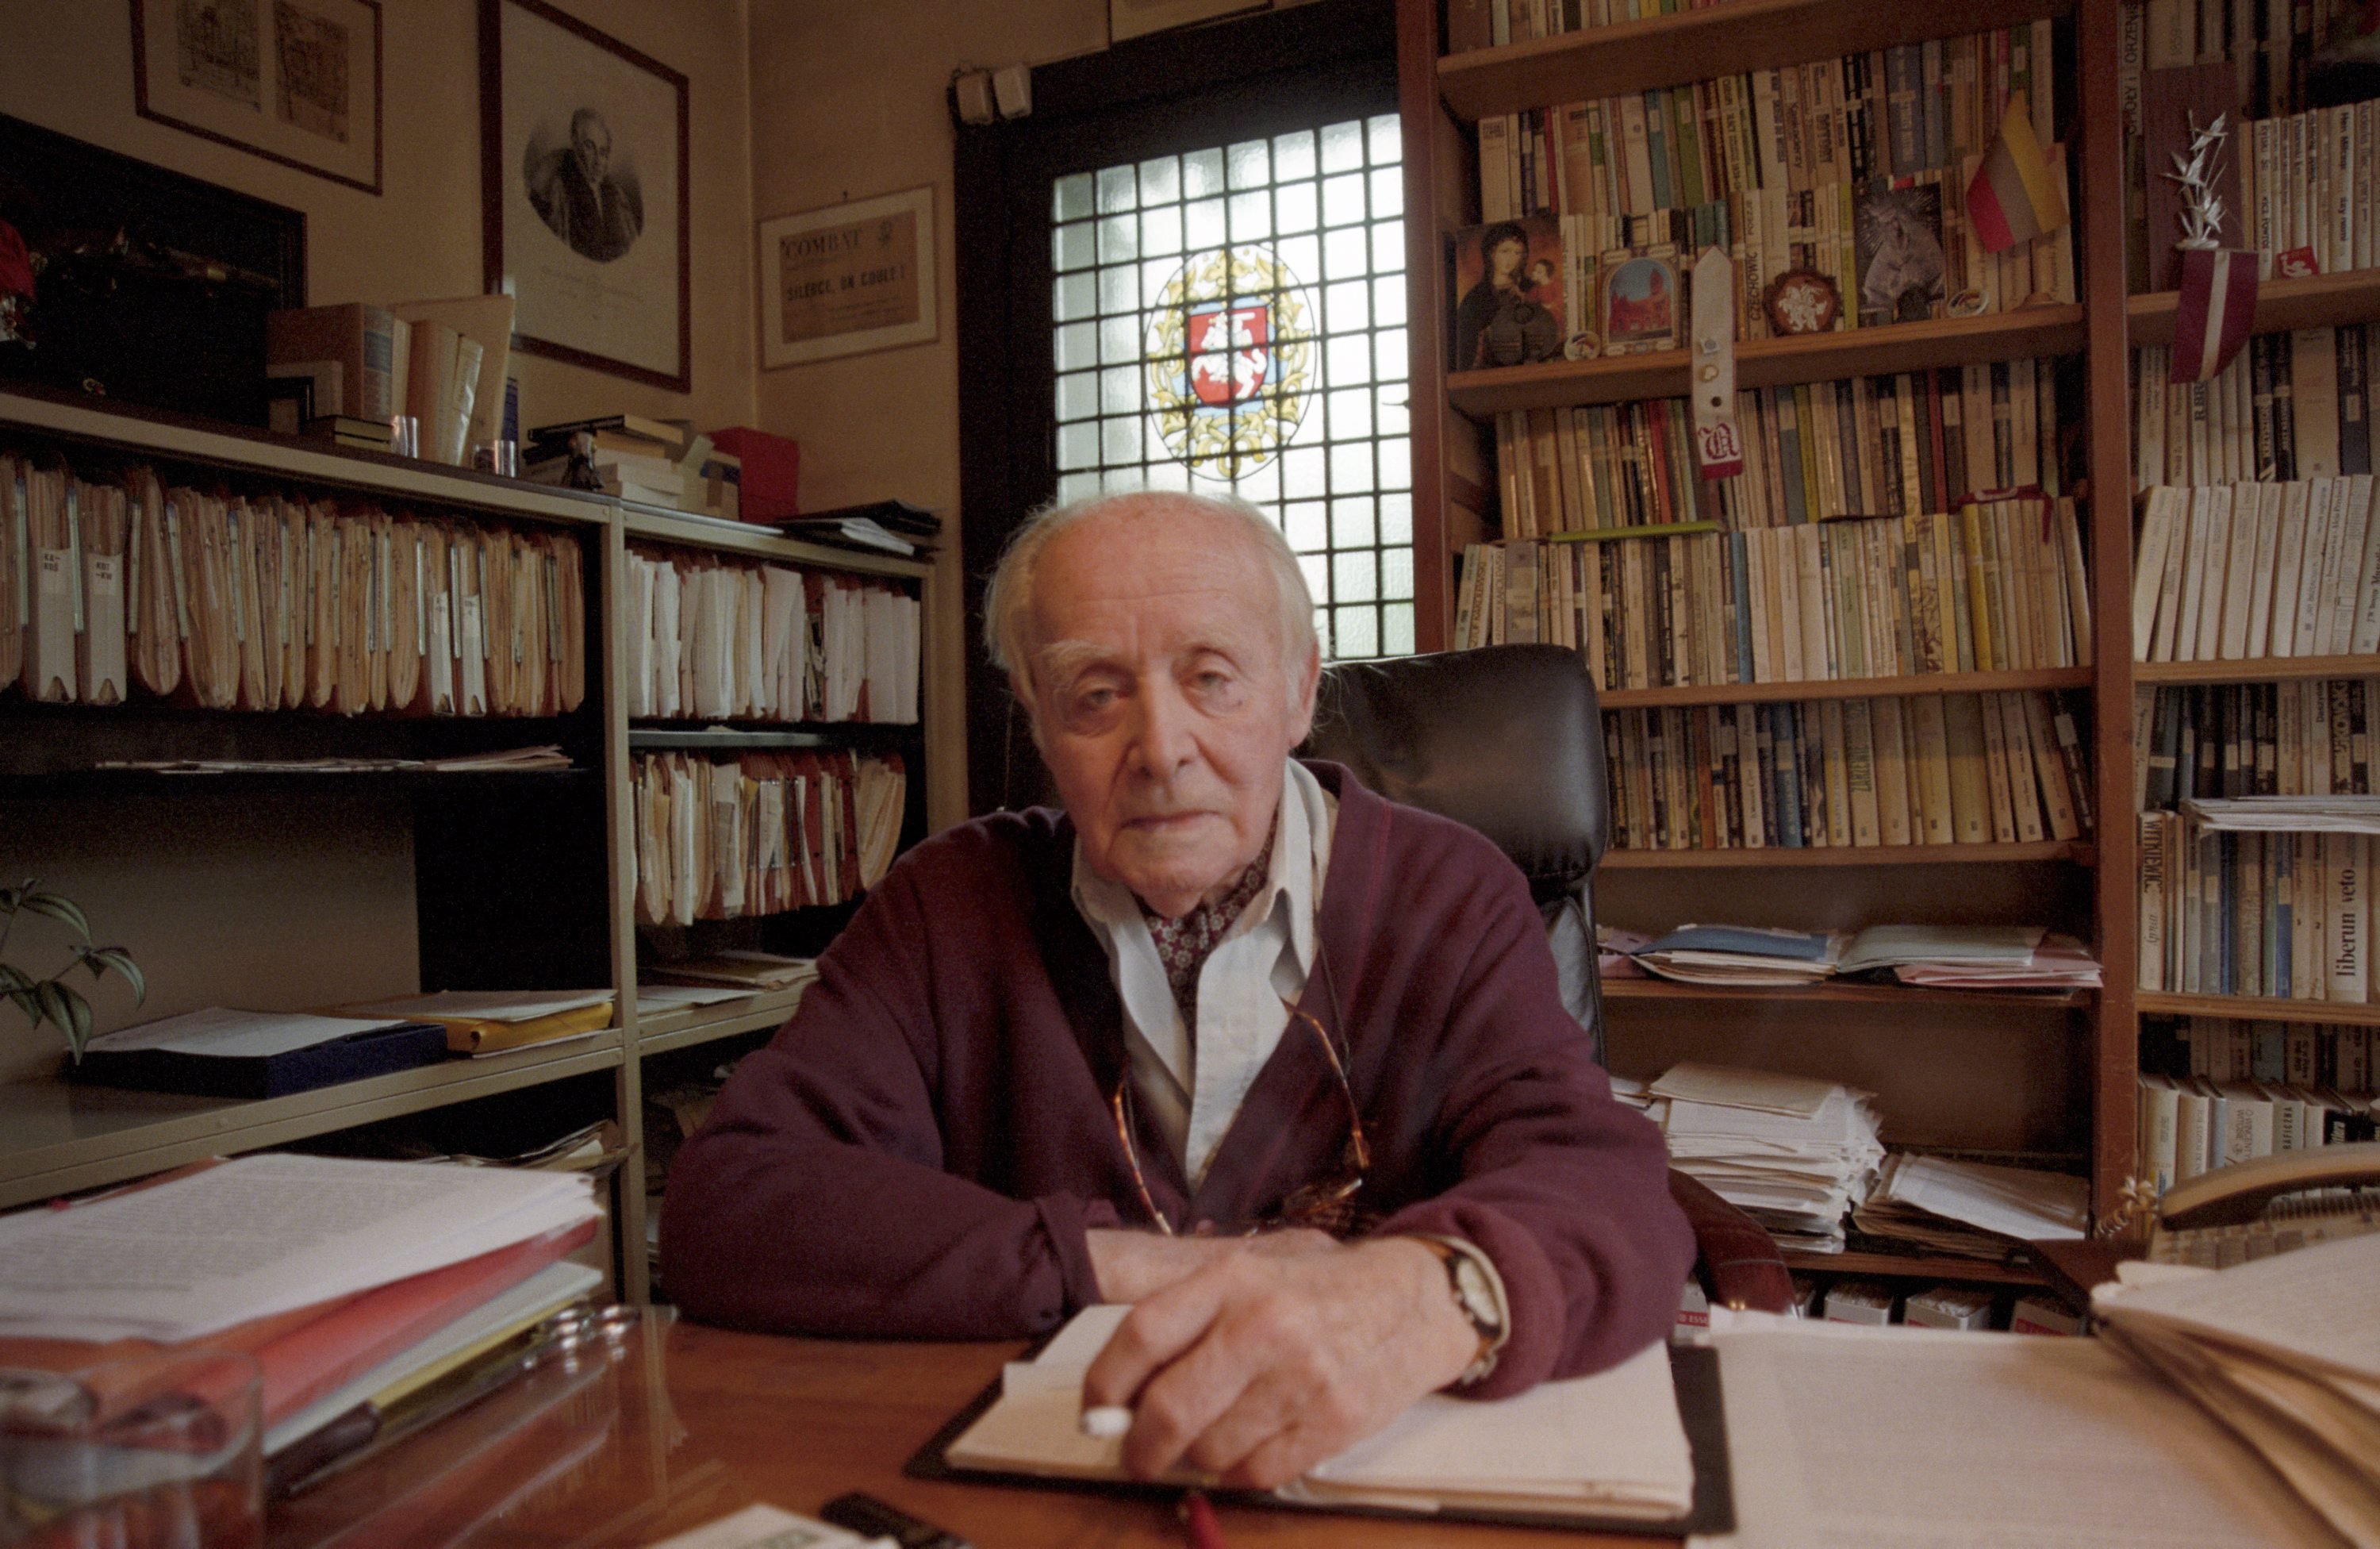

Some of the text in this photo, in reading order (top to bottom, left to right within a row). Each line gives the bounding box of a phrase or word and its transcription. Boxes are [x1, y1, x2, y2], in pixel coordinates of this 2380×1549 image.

[1790, 102, 1802, 168] Kaskaderzy
[781, 228, 863, 258] COMBAT
[840, 274, 855, 290] ON
[1747, 252, 1760, 321] CZECHOWIC
[2244, 1117, 2253, 1159] WINCENTY
[2282, 1106, 2293, 1150] RAFICZNA
